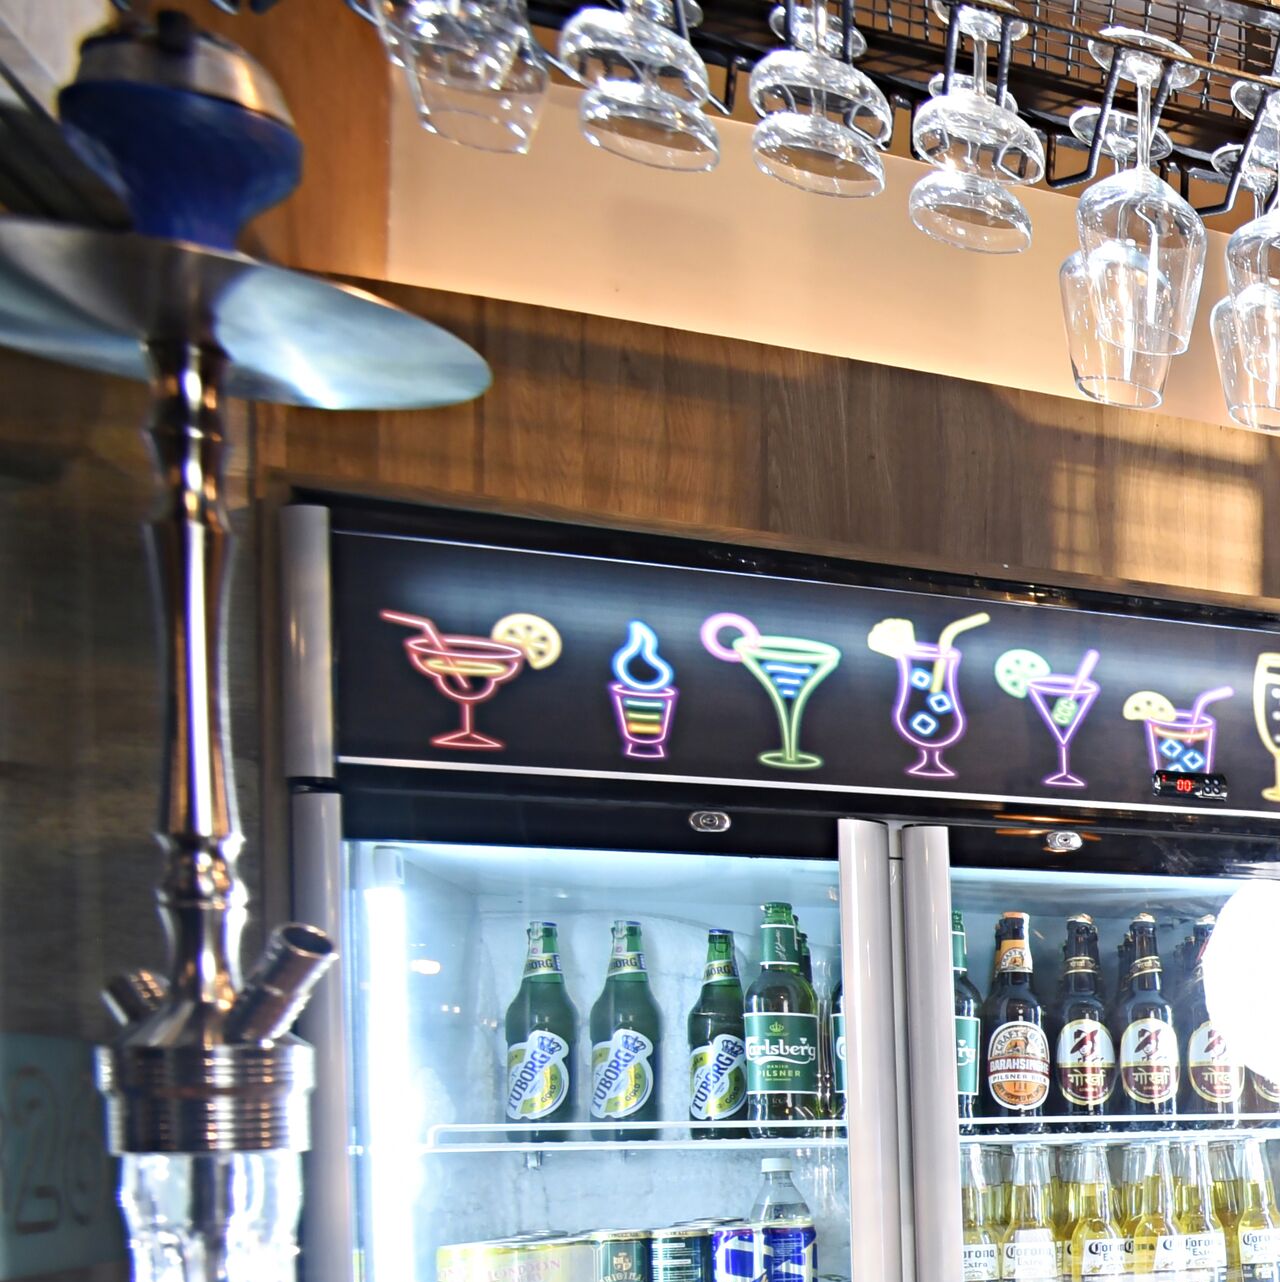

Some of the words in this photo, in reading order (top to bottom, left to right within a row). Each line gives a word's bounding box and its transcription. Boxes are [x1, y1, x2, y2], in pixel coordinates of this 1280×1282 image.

[745, 1036, 816, 1062] Carlsberg
[995, 1030, 1019, 1052] CRAFT
[507, 1050, 552, 1111] TUBORG
[591, 1049, 636, 1110] TUBORG
